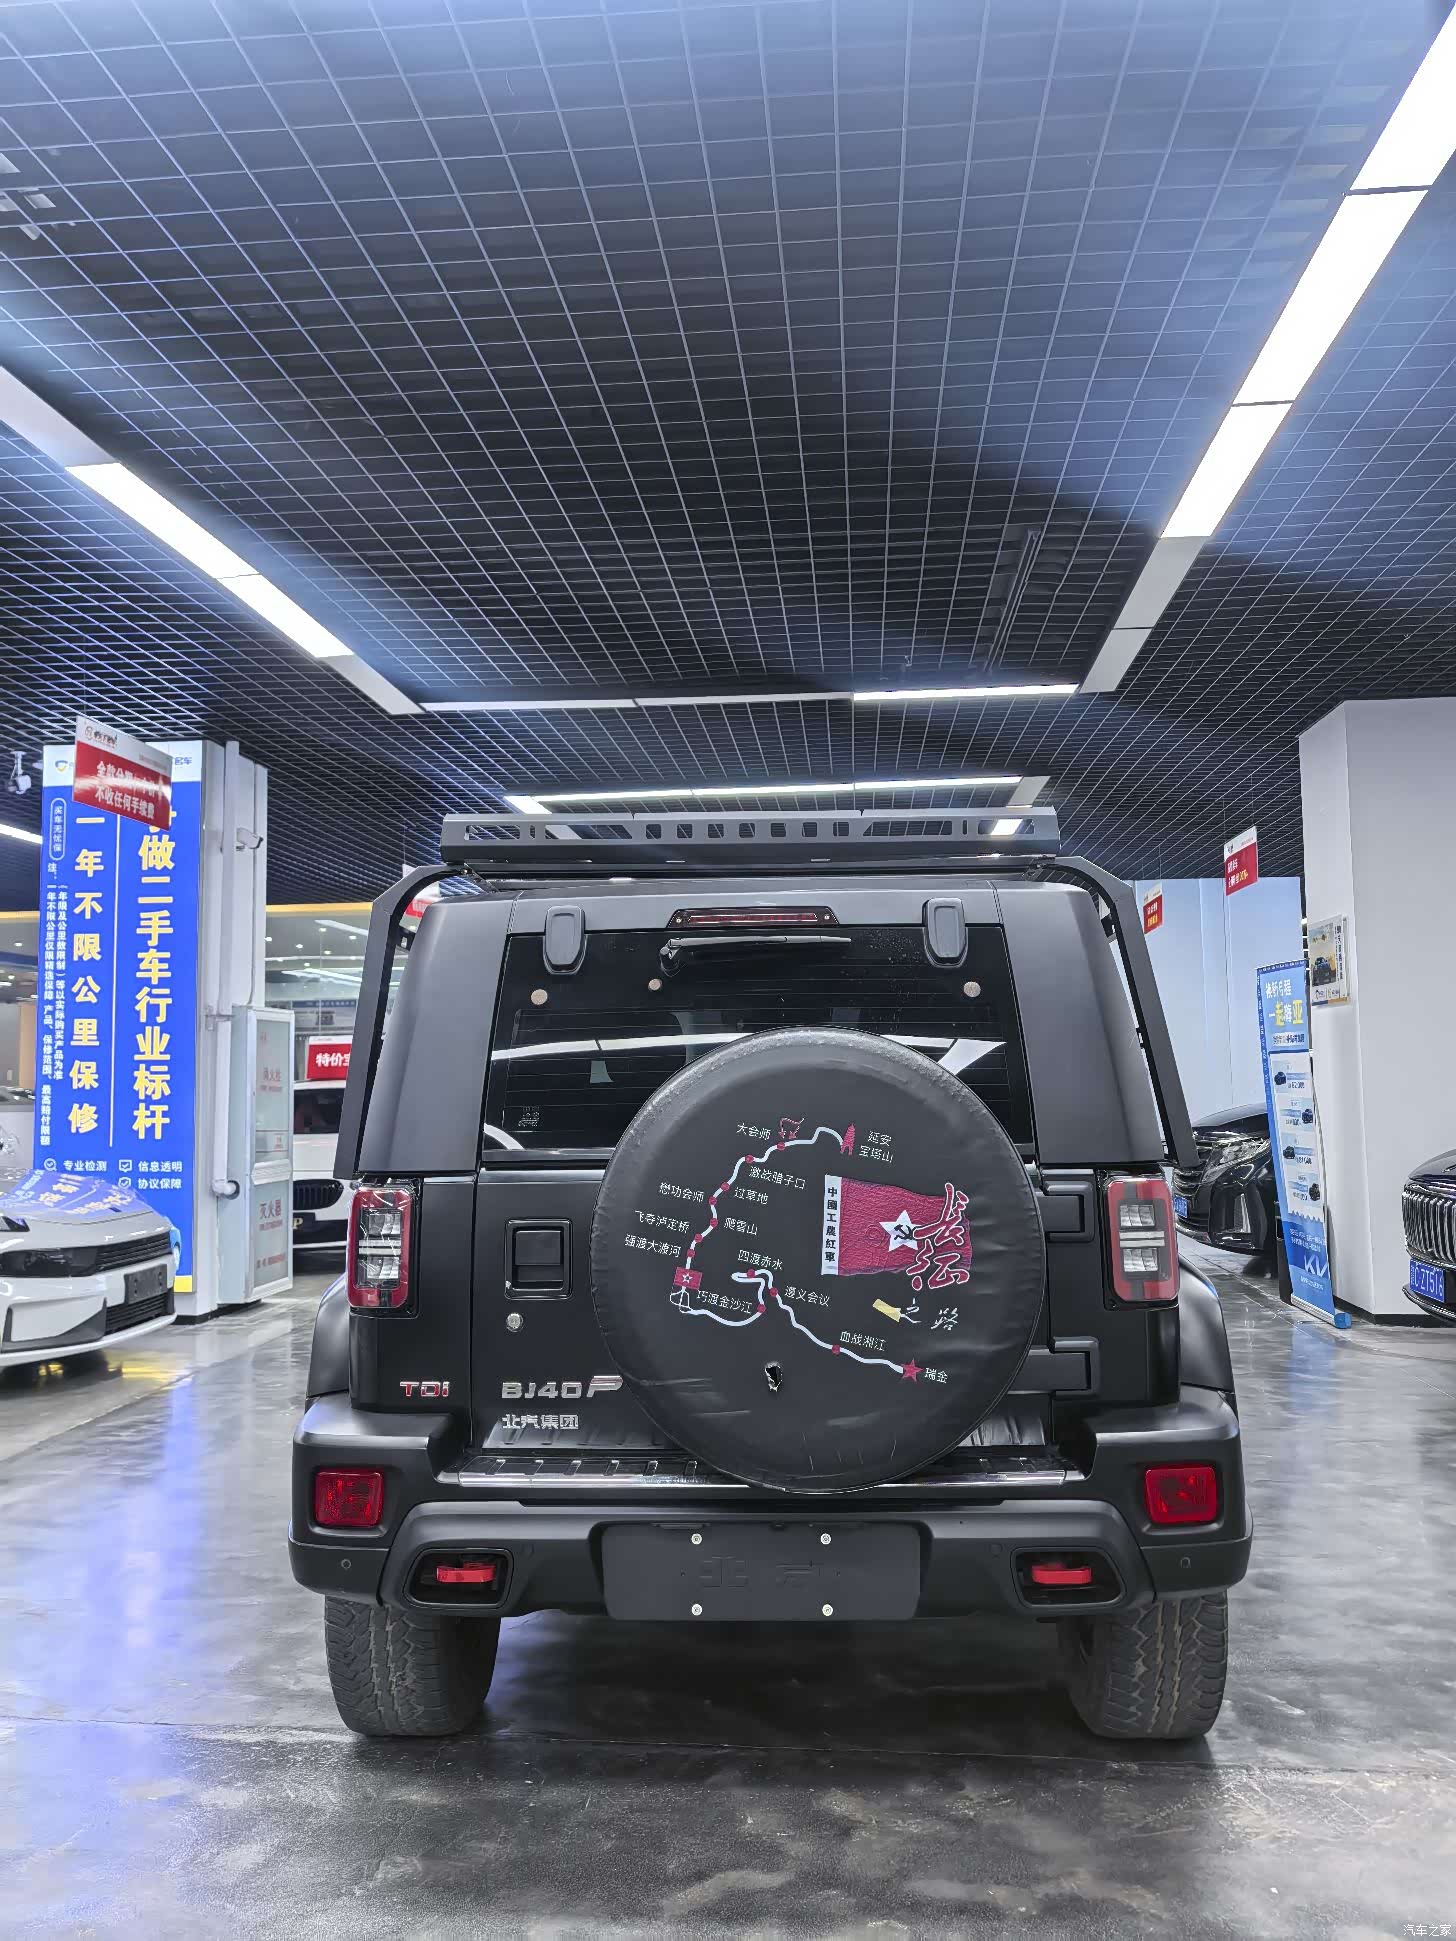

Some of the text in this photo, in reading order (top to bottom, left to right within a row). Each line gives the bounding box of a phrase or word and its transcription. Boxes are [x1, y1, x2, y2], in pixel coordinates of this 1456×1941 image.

[68, 816, 105, 1134] 一年不限公里保修
[736, 1122, 771, 1141] 大会师
[867, 1130, 892, 1147] 延安
[859, 1145, 894, 1164] 宝塔山
[63, 1160, 107, 1173] 专业检测
[138, 1160, 183, 1173] 信息透明
[137, 1177, 182, 1190] 协议保障
[734, 1187, 769, 1205] 过草地
[635, 1210, 690, 1234] 飞夺泸定桥
[724, 1217, 758, 1236] 爬雪山
[624, 1234, 681, 1258] 强渡大渡河
[738, 1249, 783, 1270] 四渡赤水
[697, 1290, 753, 1314] 巧渡金沙江
[784, 1285, 830, 1307] 遵义会议
[839, 1330, 886, 1353] 血战湘江
[924, 1366, 949, 1385] 瑞金
[502, 1414, 579, 1430] 北汽集团
